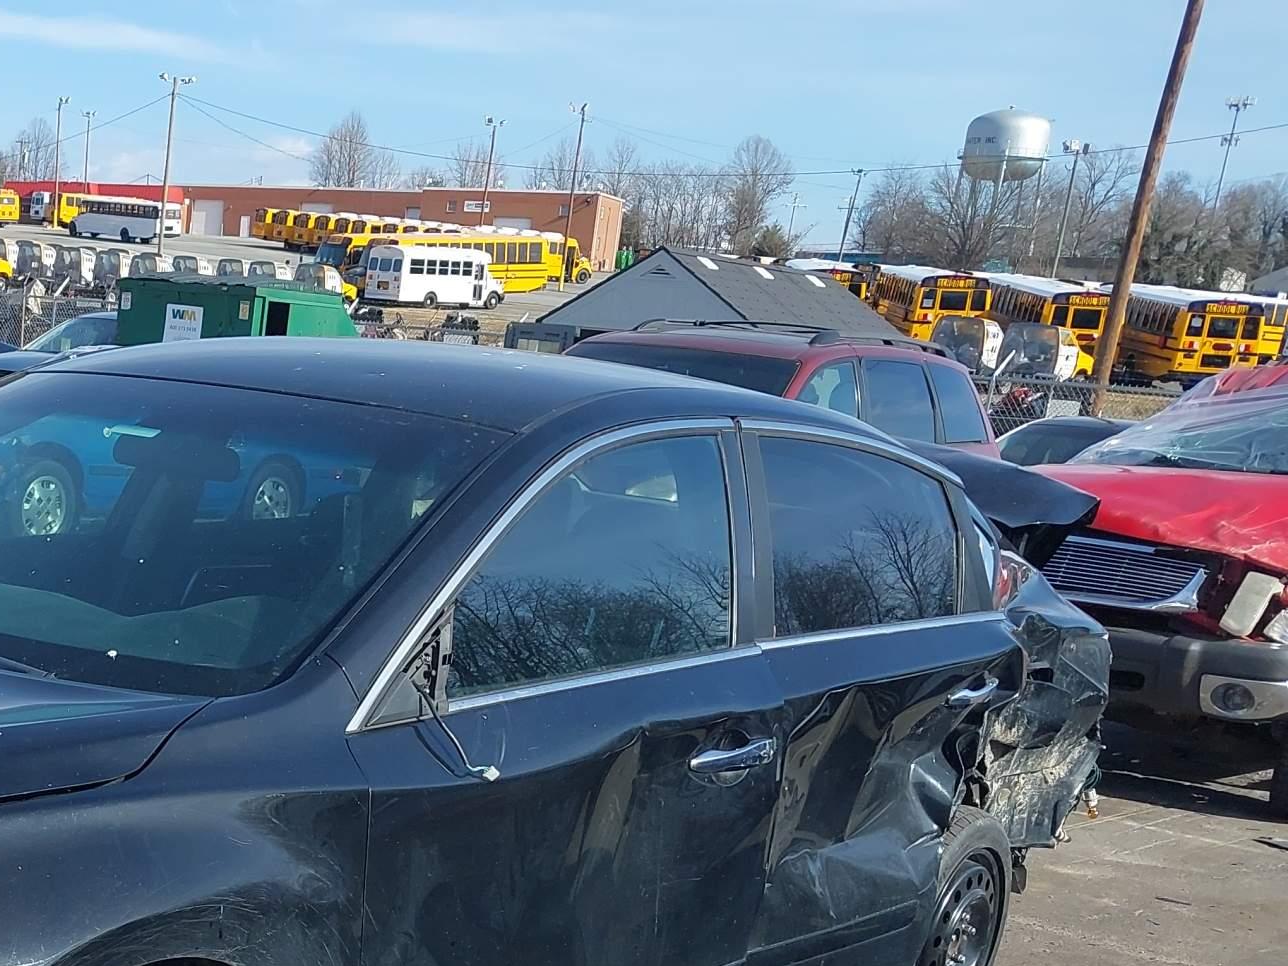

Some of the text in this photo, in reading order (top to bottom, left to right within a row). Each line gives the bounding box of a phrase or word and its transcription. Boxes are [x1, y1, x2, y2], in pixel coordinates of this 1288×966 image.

[937, 279, 976, 288] SCHOOL BUS
[1070, 295, 1110, 306] SCHOOL BUS
[1207, 303, 1249, 314] SCHOOL BUS
[172, 308, 196, 321] WM
